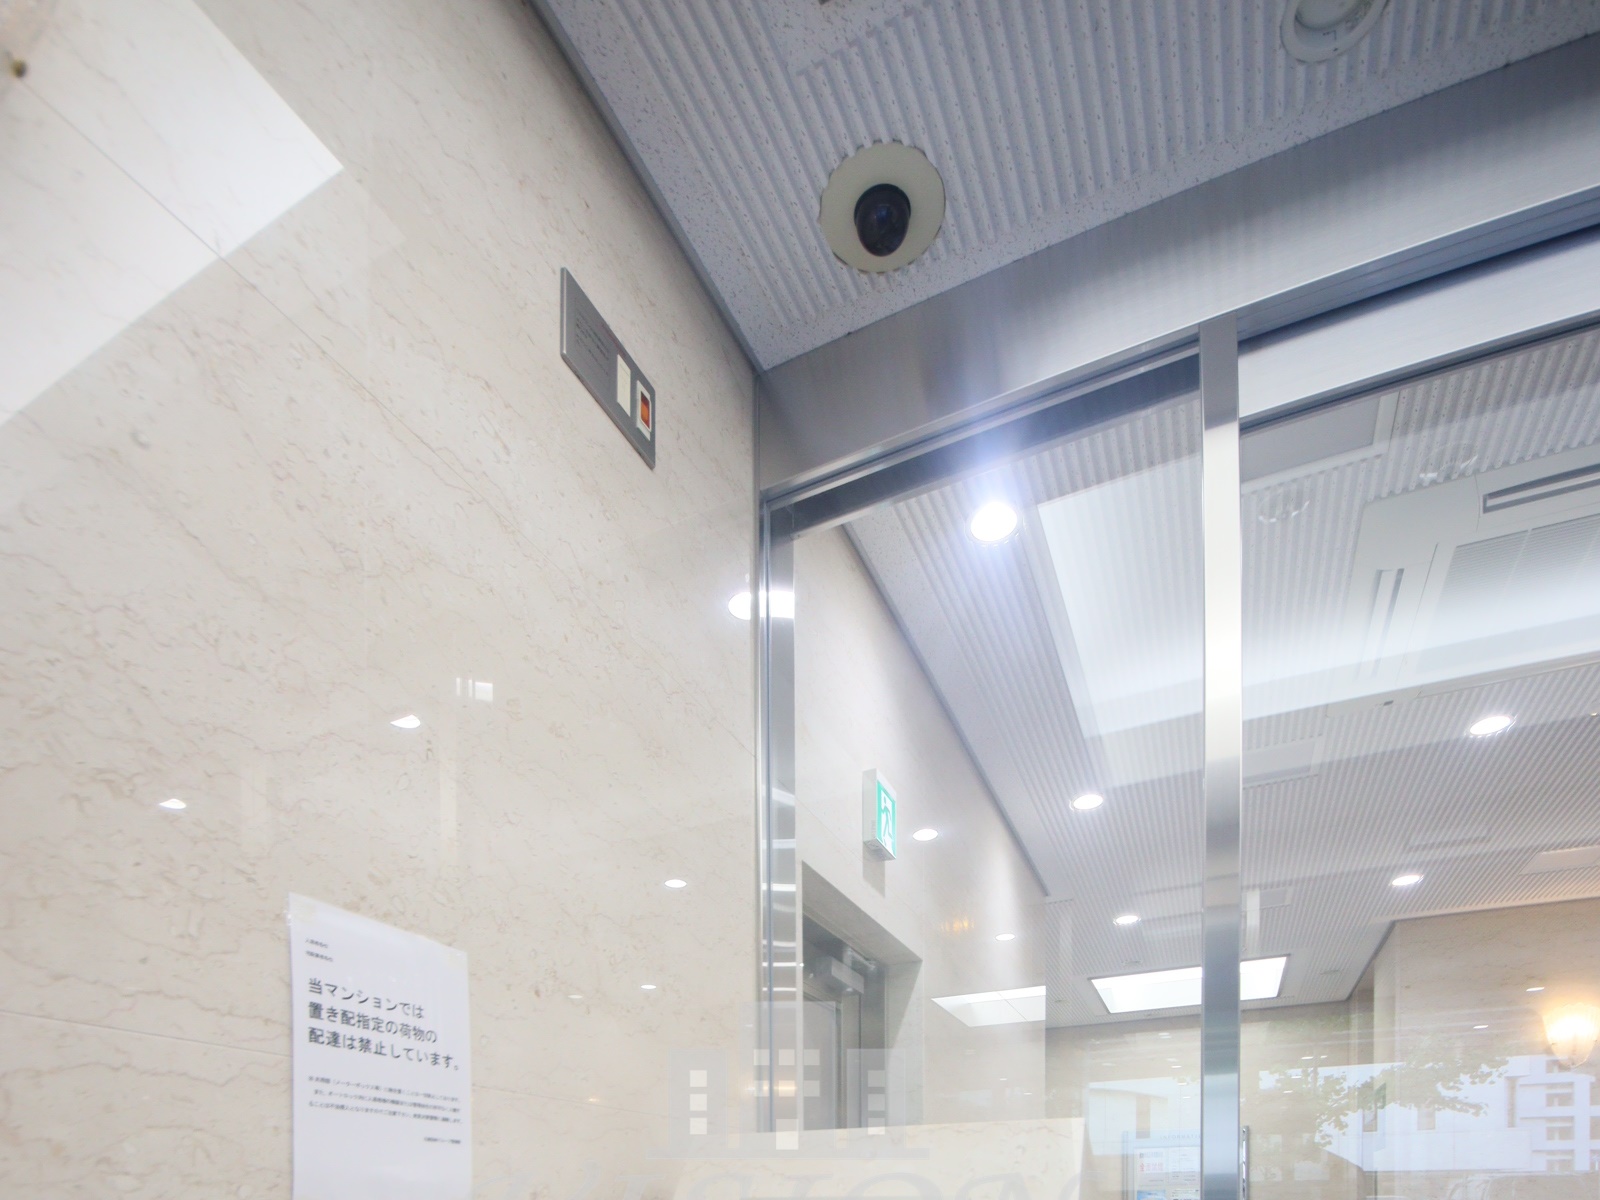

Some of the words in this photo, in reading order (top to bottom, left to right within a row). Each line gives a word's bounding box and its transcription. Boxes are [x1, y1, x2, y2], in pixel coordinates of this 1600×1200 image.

[308, 977, 425, 1018] 当マンションでは
[308, 1001, 437, 1043] 置き配指定の荷物の
[308, 1026, 459, 1070] 配達は禁止しています。
